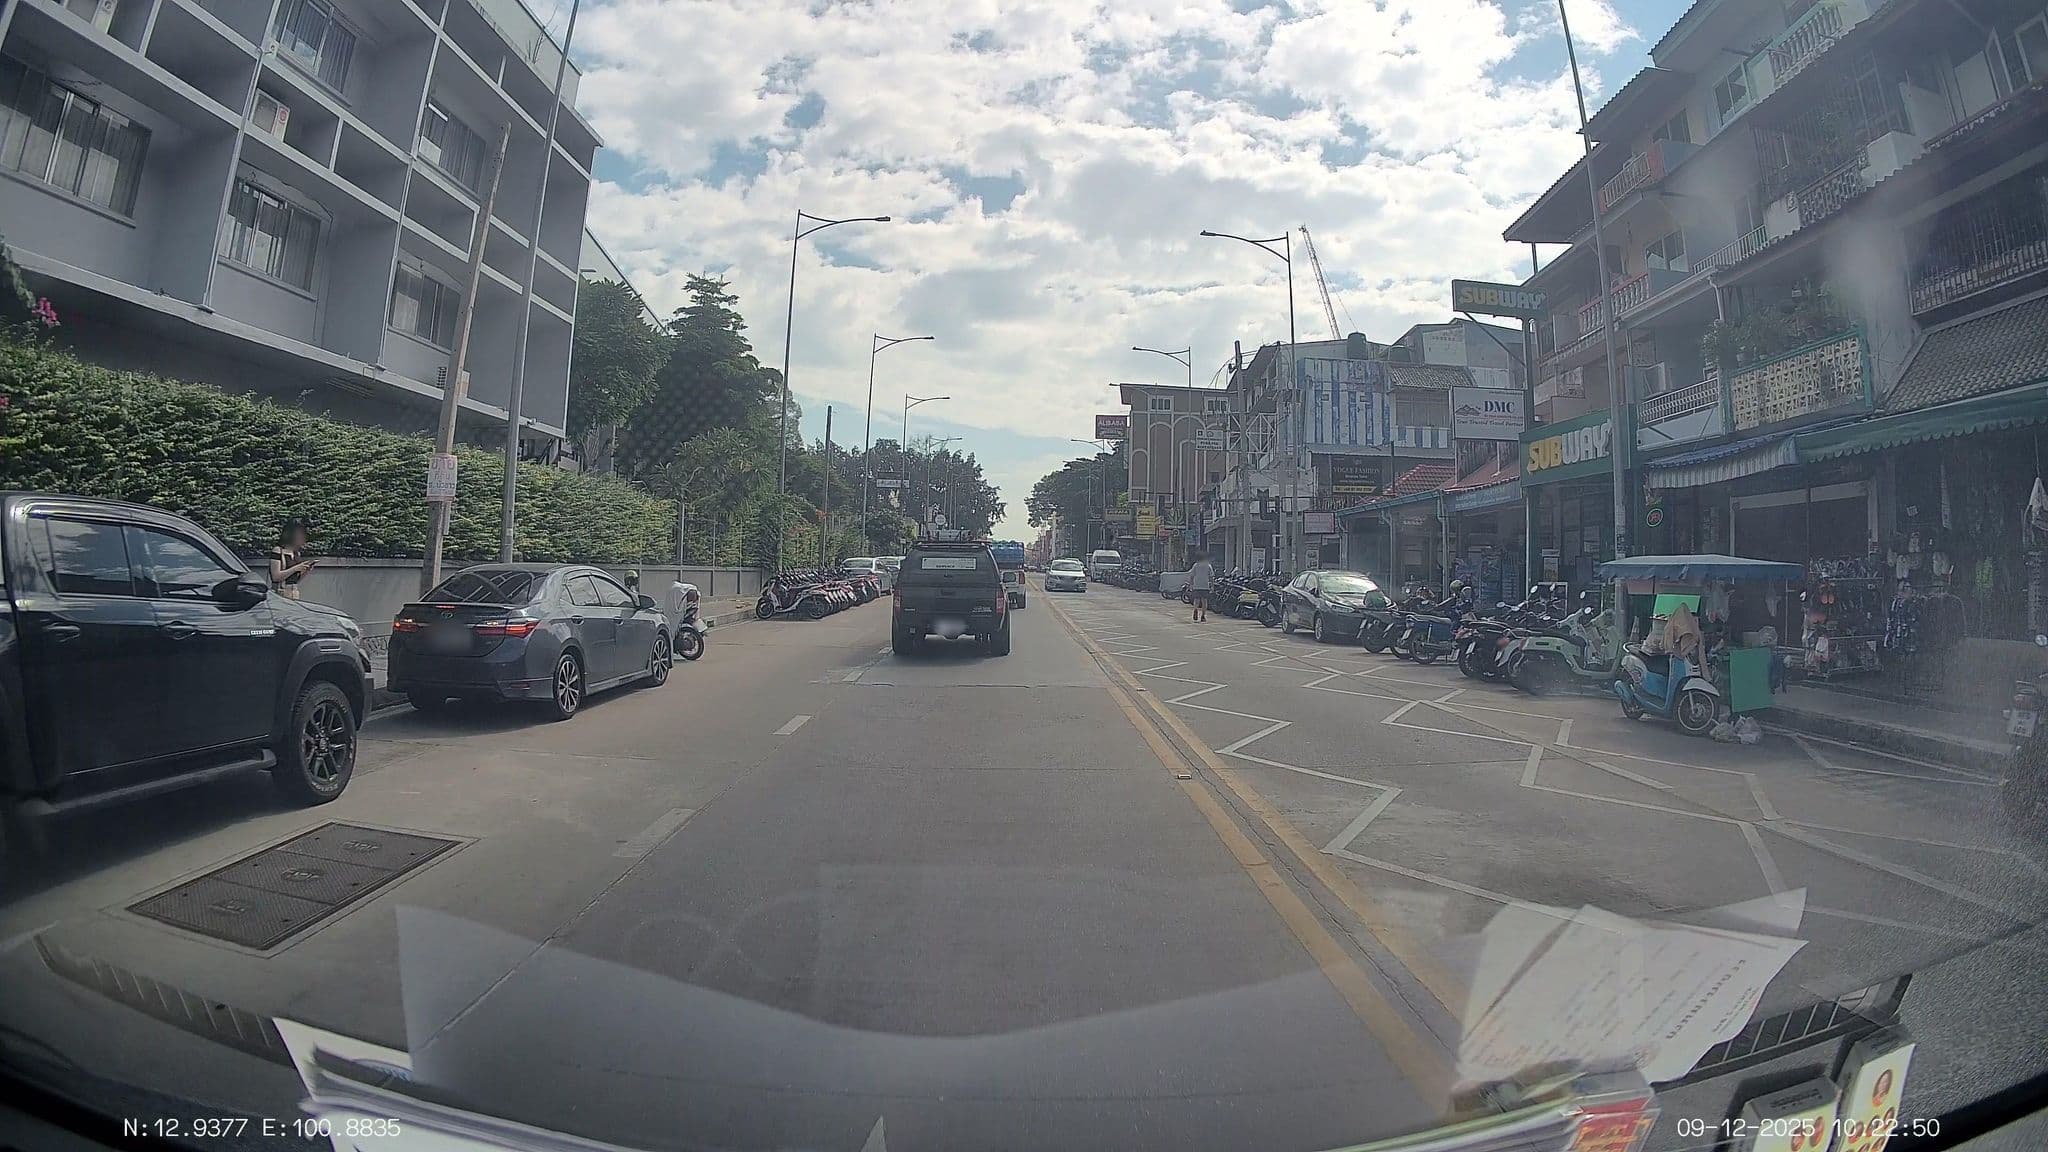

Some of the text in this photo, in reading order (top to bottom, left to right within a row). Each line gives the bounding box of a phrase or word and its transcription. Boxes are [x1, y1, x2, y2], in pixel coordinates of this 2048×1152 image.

[1460, 286, 1547, 310] SUBWAY
[1483, 400, 1515, 414] DMC
[1526, 418, 1613, 474] SUBWAY
